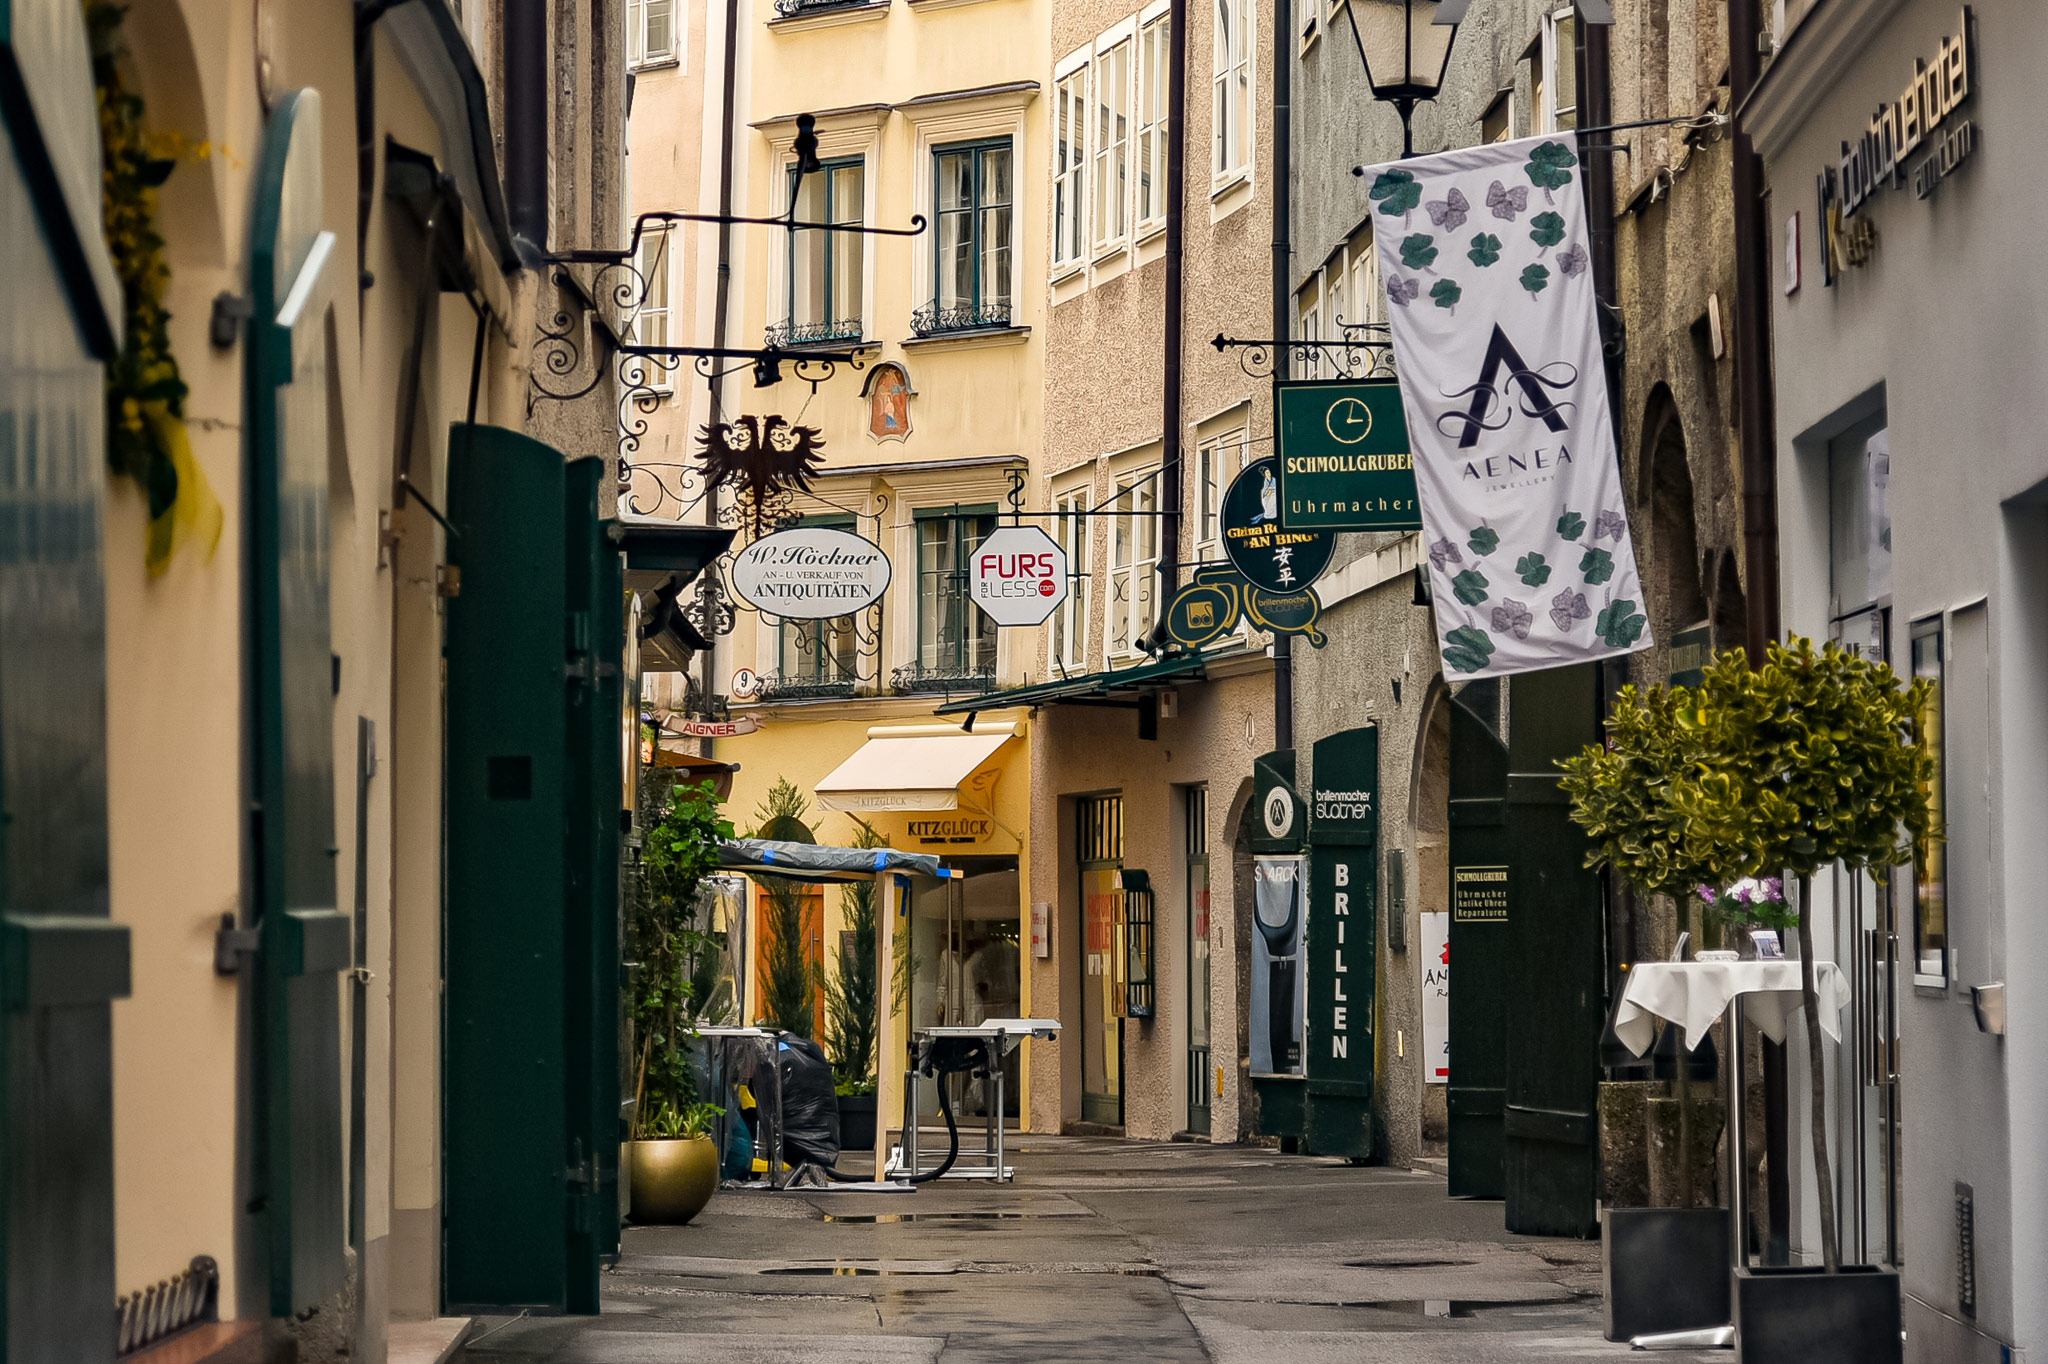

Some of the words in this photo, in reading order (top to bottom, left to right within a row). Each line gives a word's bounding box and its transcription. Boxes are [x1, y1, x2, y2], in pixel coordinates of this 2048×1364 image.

[1913, 154, 1938, 200] am
[1939, 120, 1973, 177] dom
[1463, 444, 1573, 480] AENEA
[1485, 475, 1556, 492] JEWELLERY
[1292, 497, 1413, 513] Uhrmacher
[1227, 526, 1263, 538] China
[980, 553, 1054, 579] FURS
[1272, 546, 1297, 588] 安平
[797, 571, 842, 579] VERKAUF
[844, 571, 864, 579] VON
[753, 581, 872, 600] ANTIQUITÄTEN
[990, 581, 1037, 598] LESS
[740, 671, 748, 688] 9
[683, 723, 737, 735] AIGNER
[1315, 789, 1371, 802] brillenmacher
[908, 818, 989, 835] KITZGLÜCK
[1458, 890, 1507, 899] Uhrmacher
[1458, 900, 1483, 908] Antike
[1484, 899, 1507, 908] Uhren
[1458, 909, 1508, 918] Reparaturen
[1332, 863, 1350, 1059] BRILLEN
